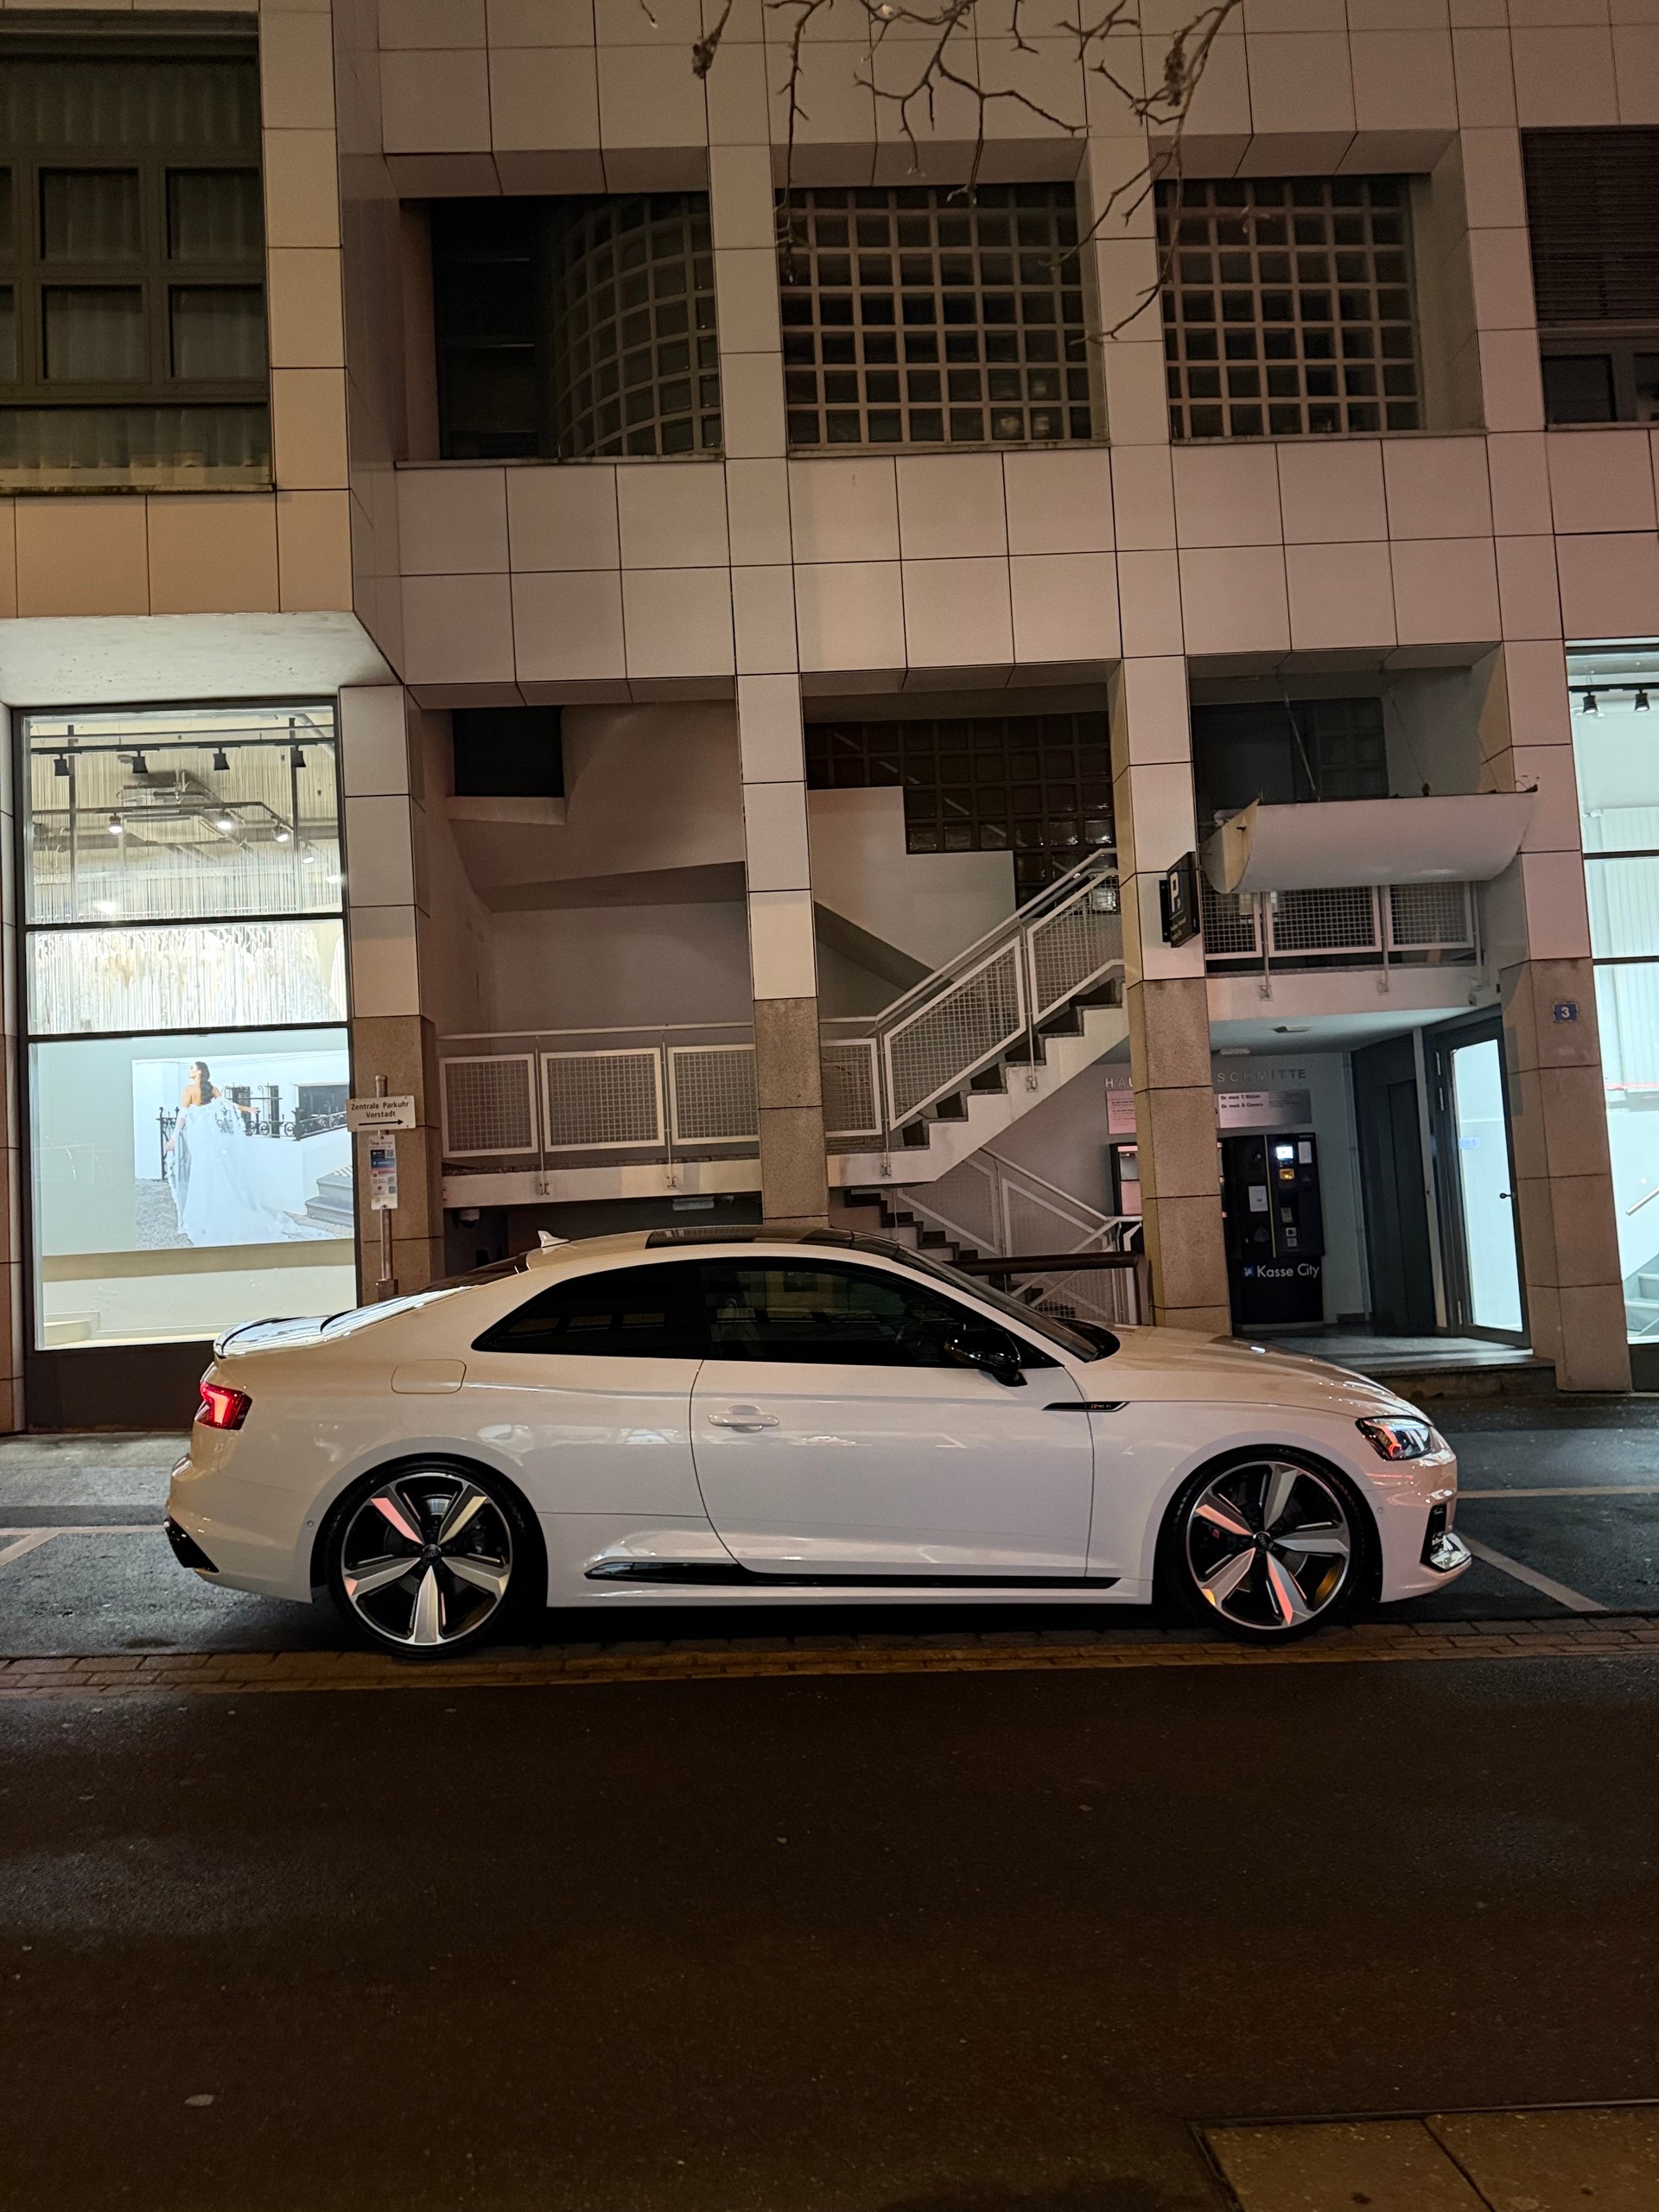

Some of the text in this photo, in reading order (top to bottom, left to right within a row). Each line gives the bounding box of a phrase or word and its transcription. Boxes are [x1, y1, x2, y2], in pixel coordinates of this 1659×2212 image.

[1170, 872, 1179, 913] P
[1560, 1007, 1571, 1018] 3
[1217, 1068, 1306, 1083] SCHMITTE
[1256, 1263, 1319, 1279] Kasse City
